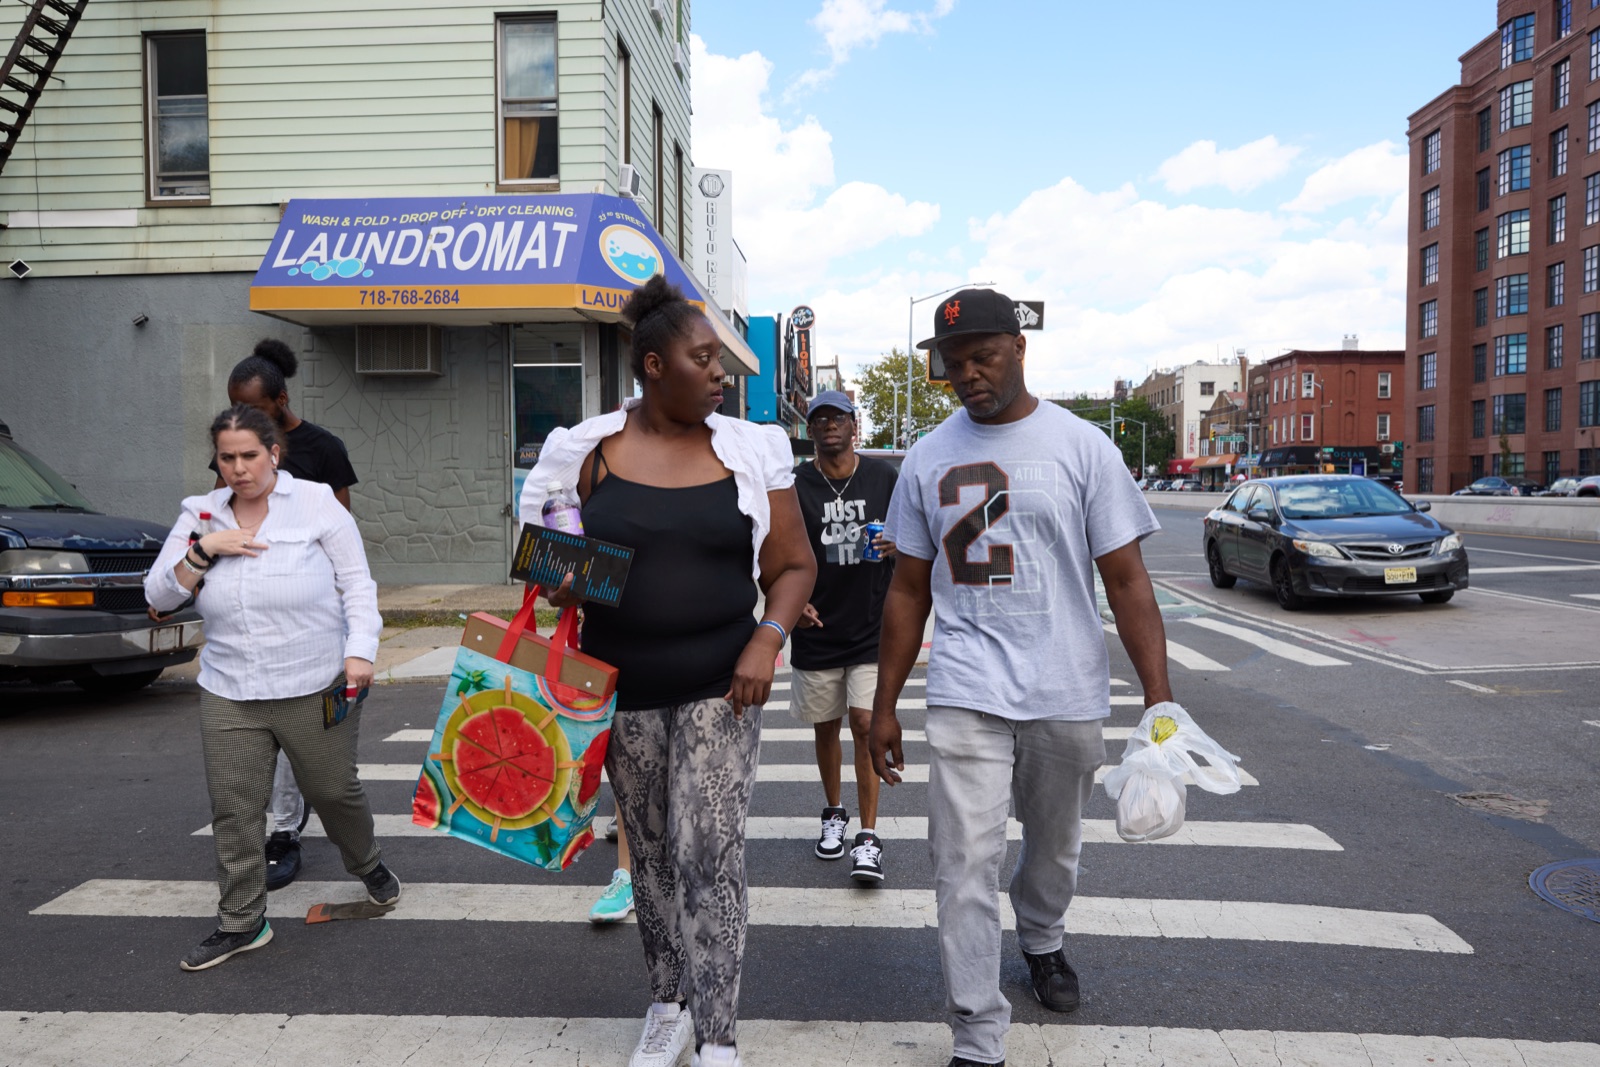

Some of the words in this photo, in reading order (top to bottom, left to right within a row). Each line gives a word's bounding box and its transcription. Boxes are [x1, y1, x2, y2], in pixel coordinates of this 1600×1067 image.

[302, 214, 339, 227] WASH
[341, 217, 350, 227] &
[354, 216, 390, 227] FOLD
[399, 211, 438, 224] DROP
[441, 208, 468, 220] OFF
[477, 205, 506, 217] DRY
[507, 205, 574, 217] CLEANING
[615, 212, 646, 229] STREET
[707, 201, 717, 255] AUTO
[272, 220, 578, 271] LAUNDROMAT
[707, 260, 718, 297] REP
[360, 289, 460, 305] 718-768-2684
[582, 289, 630, 310] LAUN
[1014, 310, 1030, 321] AY
[821, 499, 867, 523] JUST
[830, 521, 861, 545] DO
[938, 461, 1014, 586] 2
[838, 543, 860, 566] IT.
